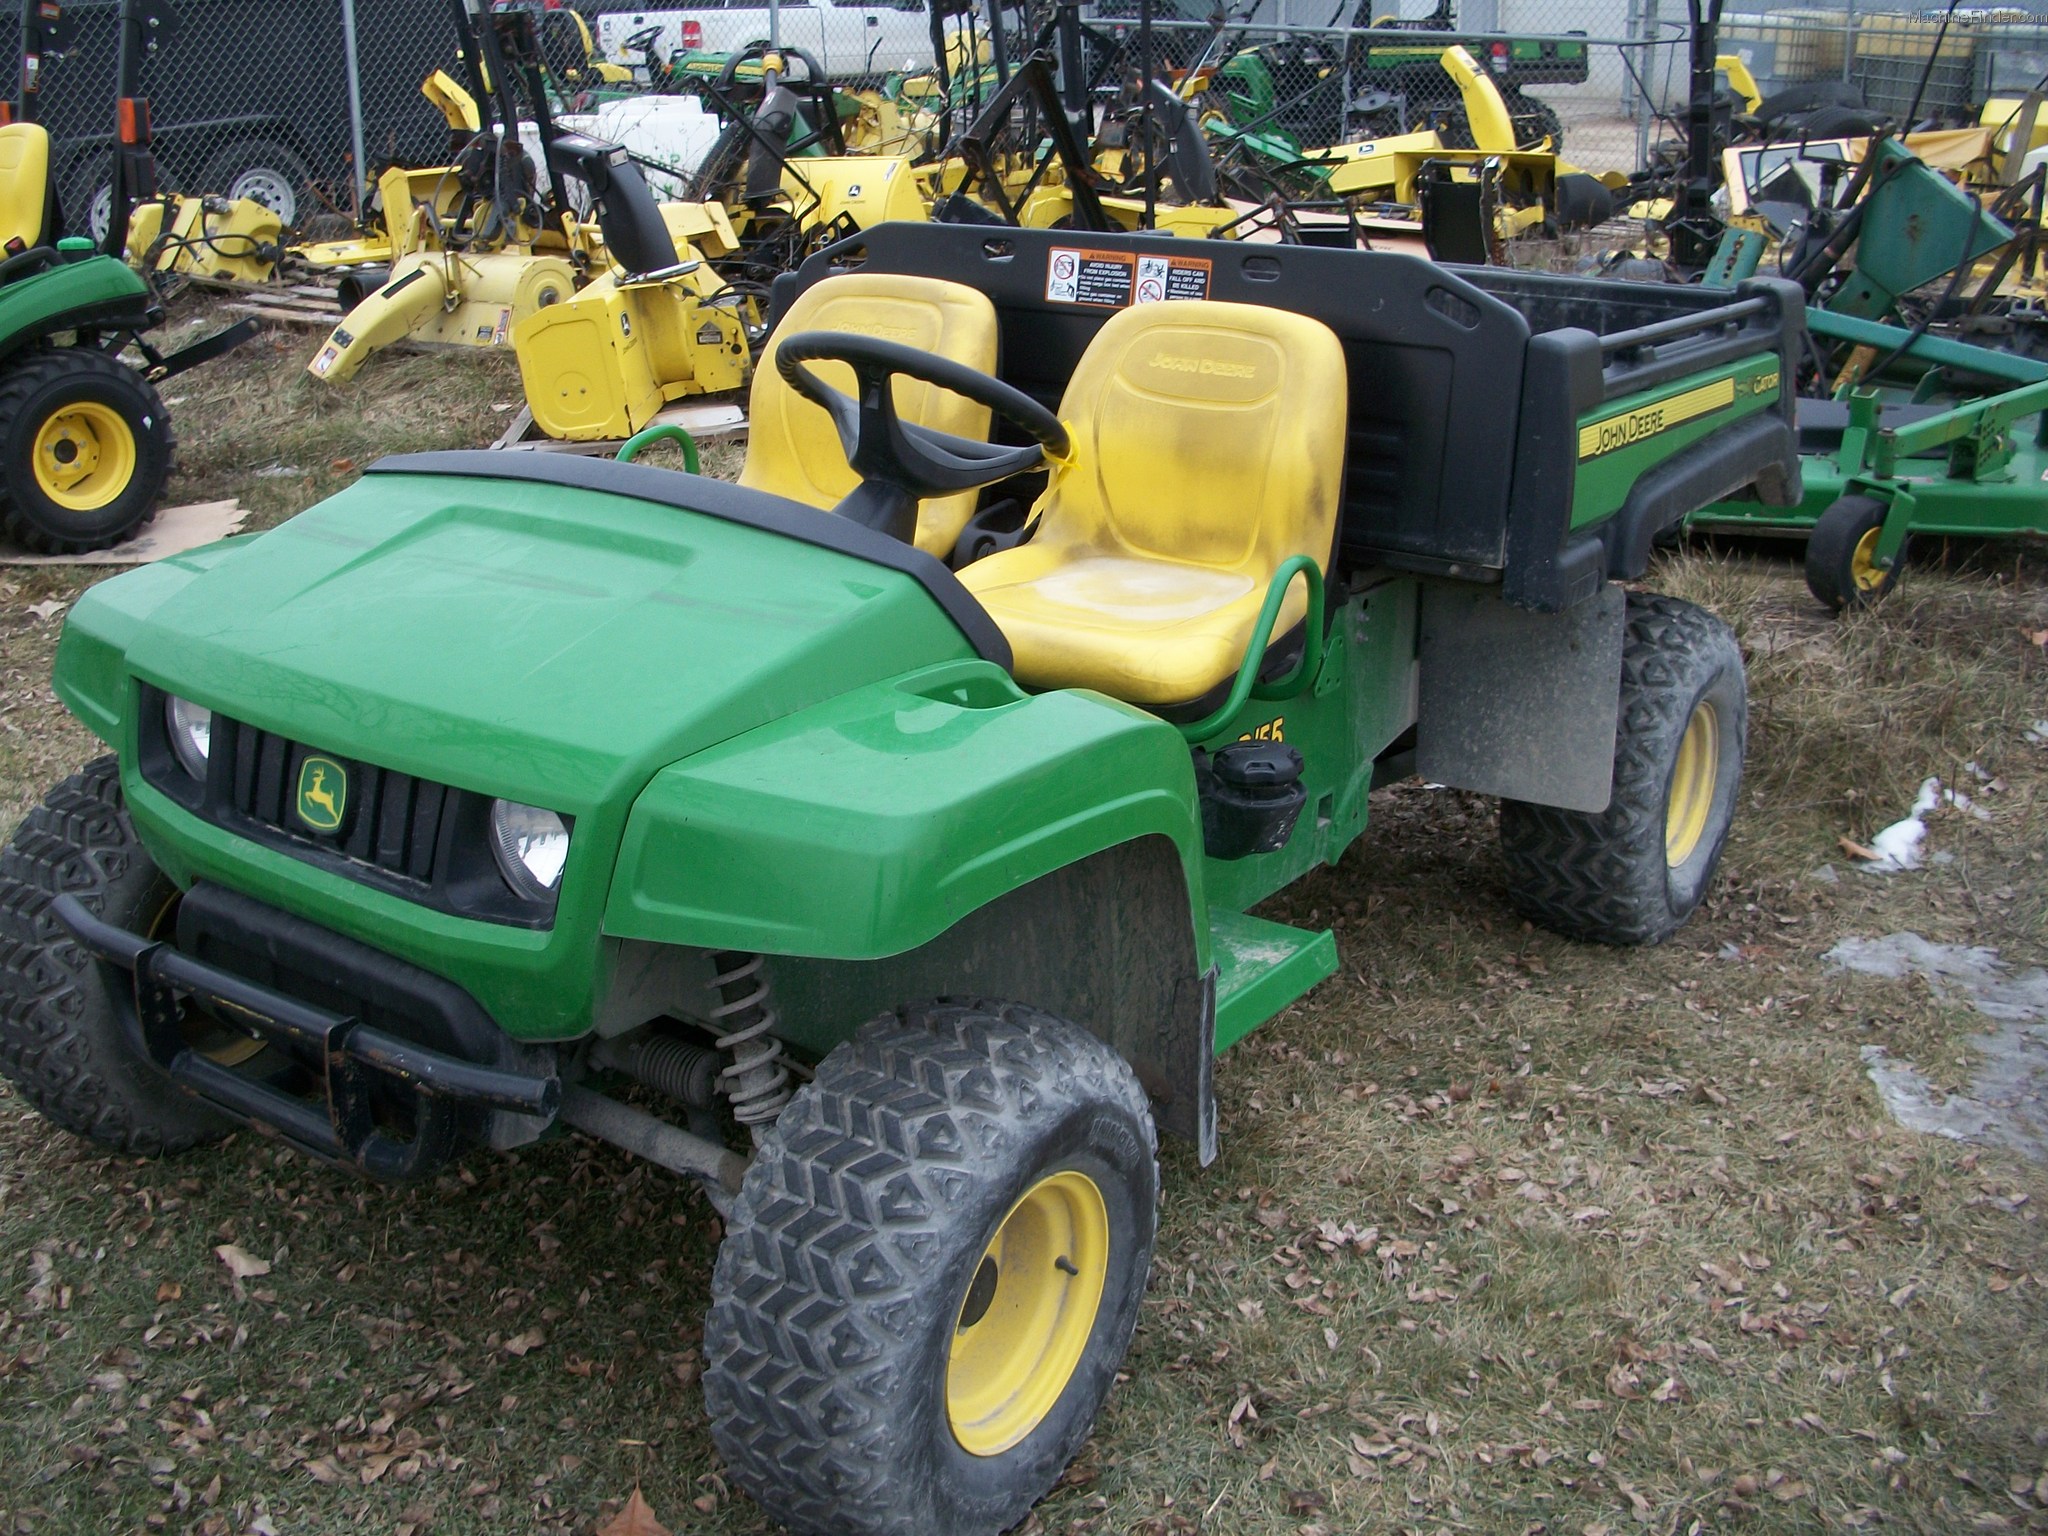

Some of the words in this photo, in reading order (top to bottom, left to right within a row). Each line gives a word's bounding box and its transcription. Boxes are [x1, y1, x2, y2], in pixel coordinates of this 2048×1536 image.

[1148, 352, 1200, 373] JOHN
[1199, 359, 1257, 379] DEERE
[1595, 422, 1628, 455] JOHN
[1628, 409, 1665, 441] DEERE
